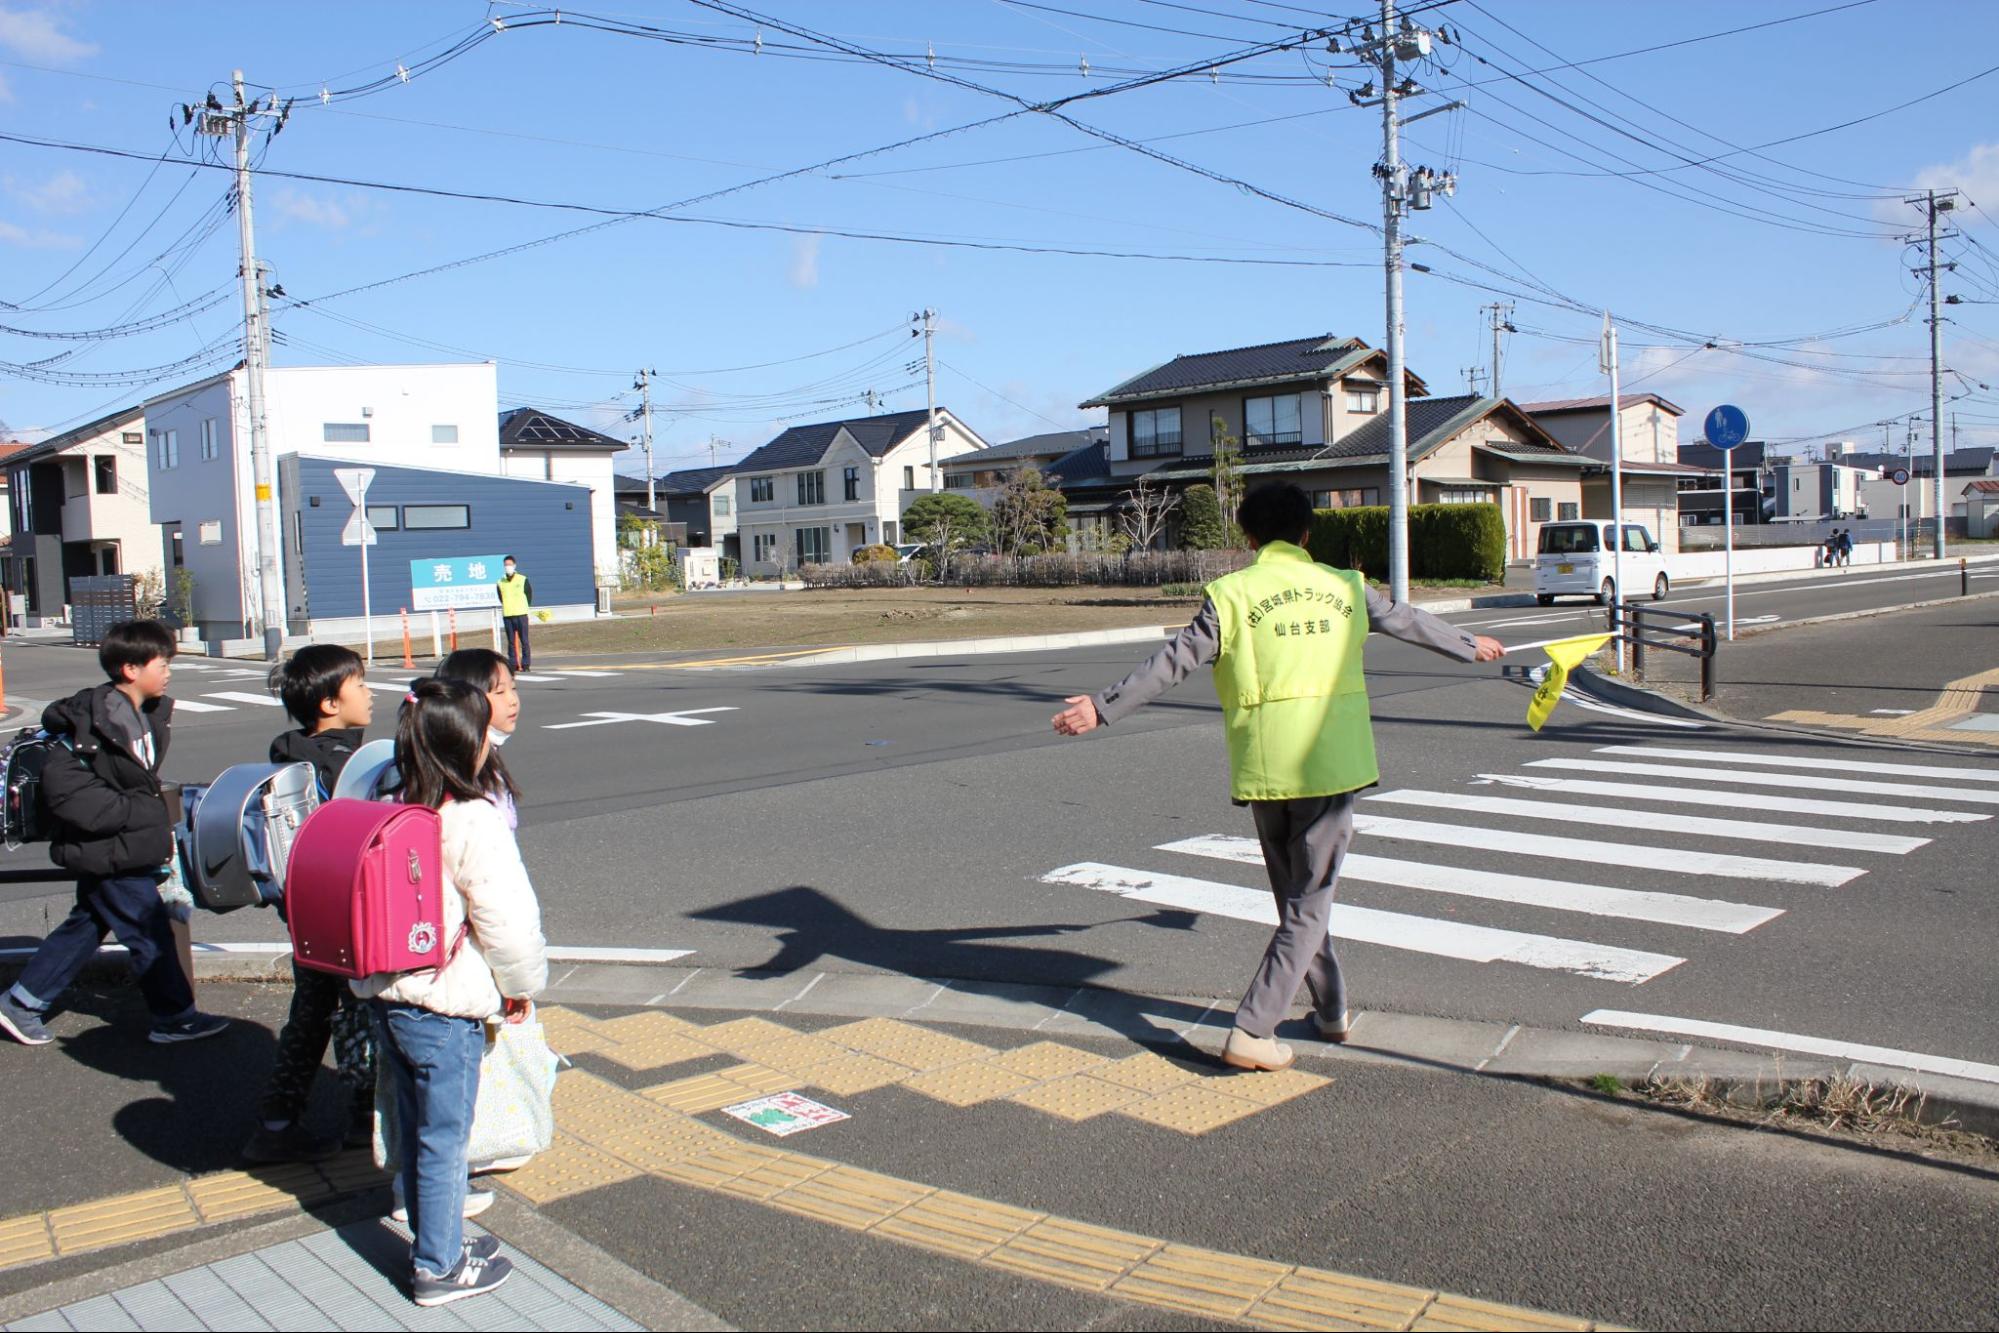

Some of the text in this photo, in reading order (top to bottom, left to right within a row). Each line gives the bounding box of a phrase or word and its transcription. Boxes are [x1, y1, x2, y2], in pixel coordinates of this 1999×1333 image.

[433, 563, 487, 582] 売地
[1274, 619, 1330, 637] 仙台支部
[458, 1265, 482, 1286] N
